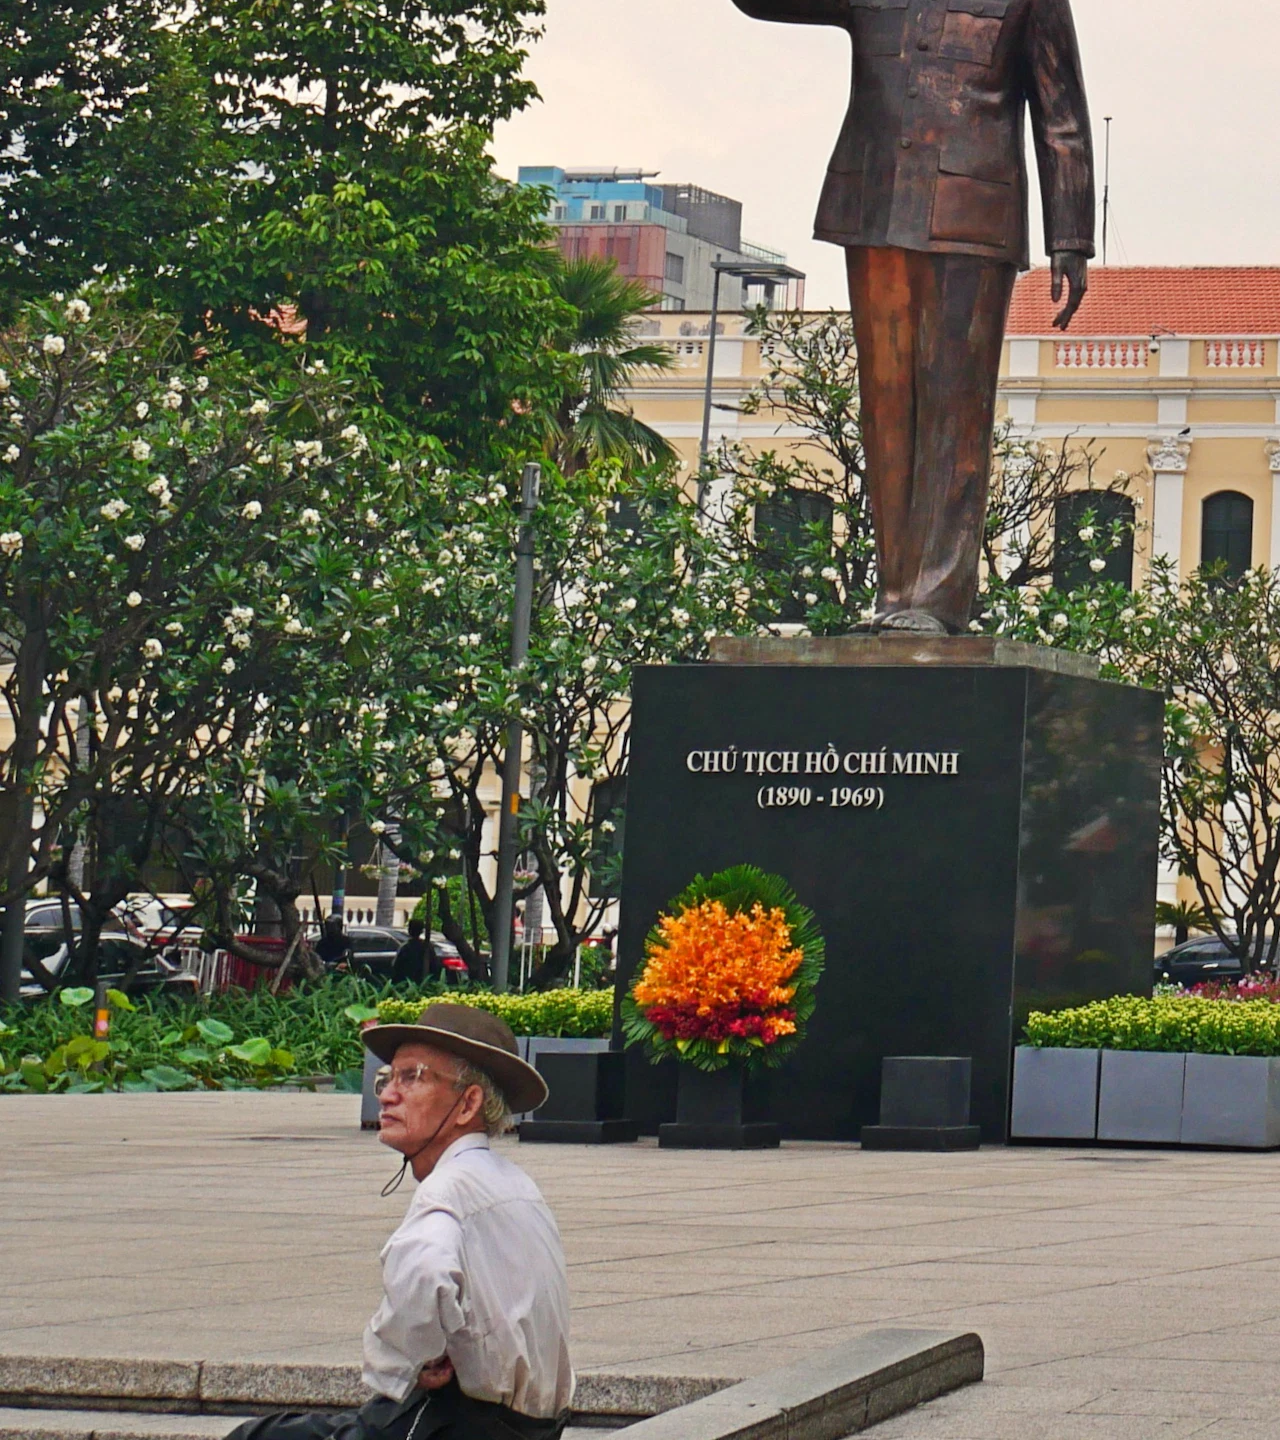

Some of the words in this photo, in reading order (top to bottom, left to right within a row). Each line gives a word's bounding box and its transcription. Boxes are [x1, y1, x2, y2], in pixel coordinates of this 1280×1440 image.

[686, 745, 738, 774] CHỦ
[743, 750, 800, 777] TỊCH
[804, 742, 840, 774] HỒ
[843, 745, 887, 774] CHÍ
[891, 751, 960, 775] MINH
[756, 785, 812, 810] (1890
[829, 786, 885, 811] 1969)
